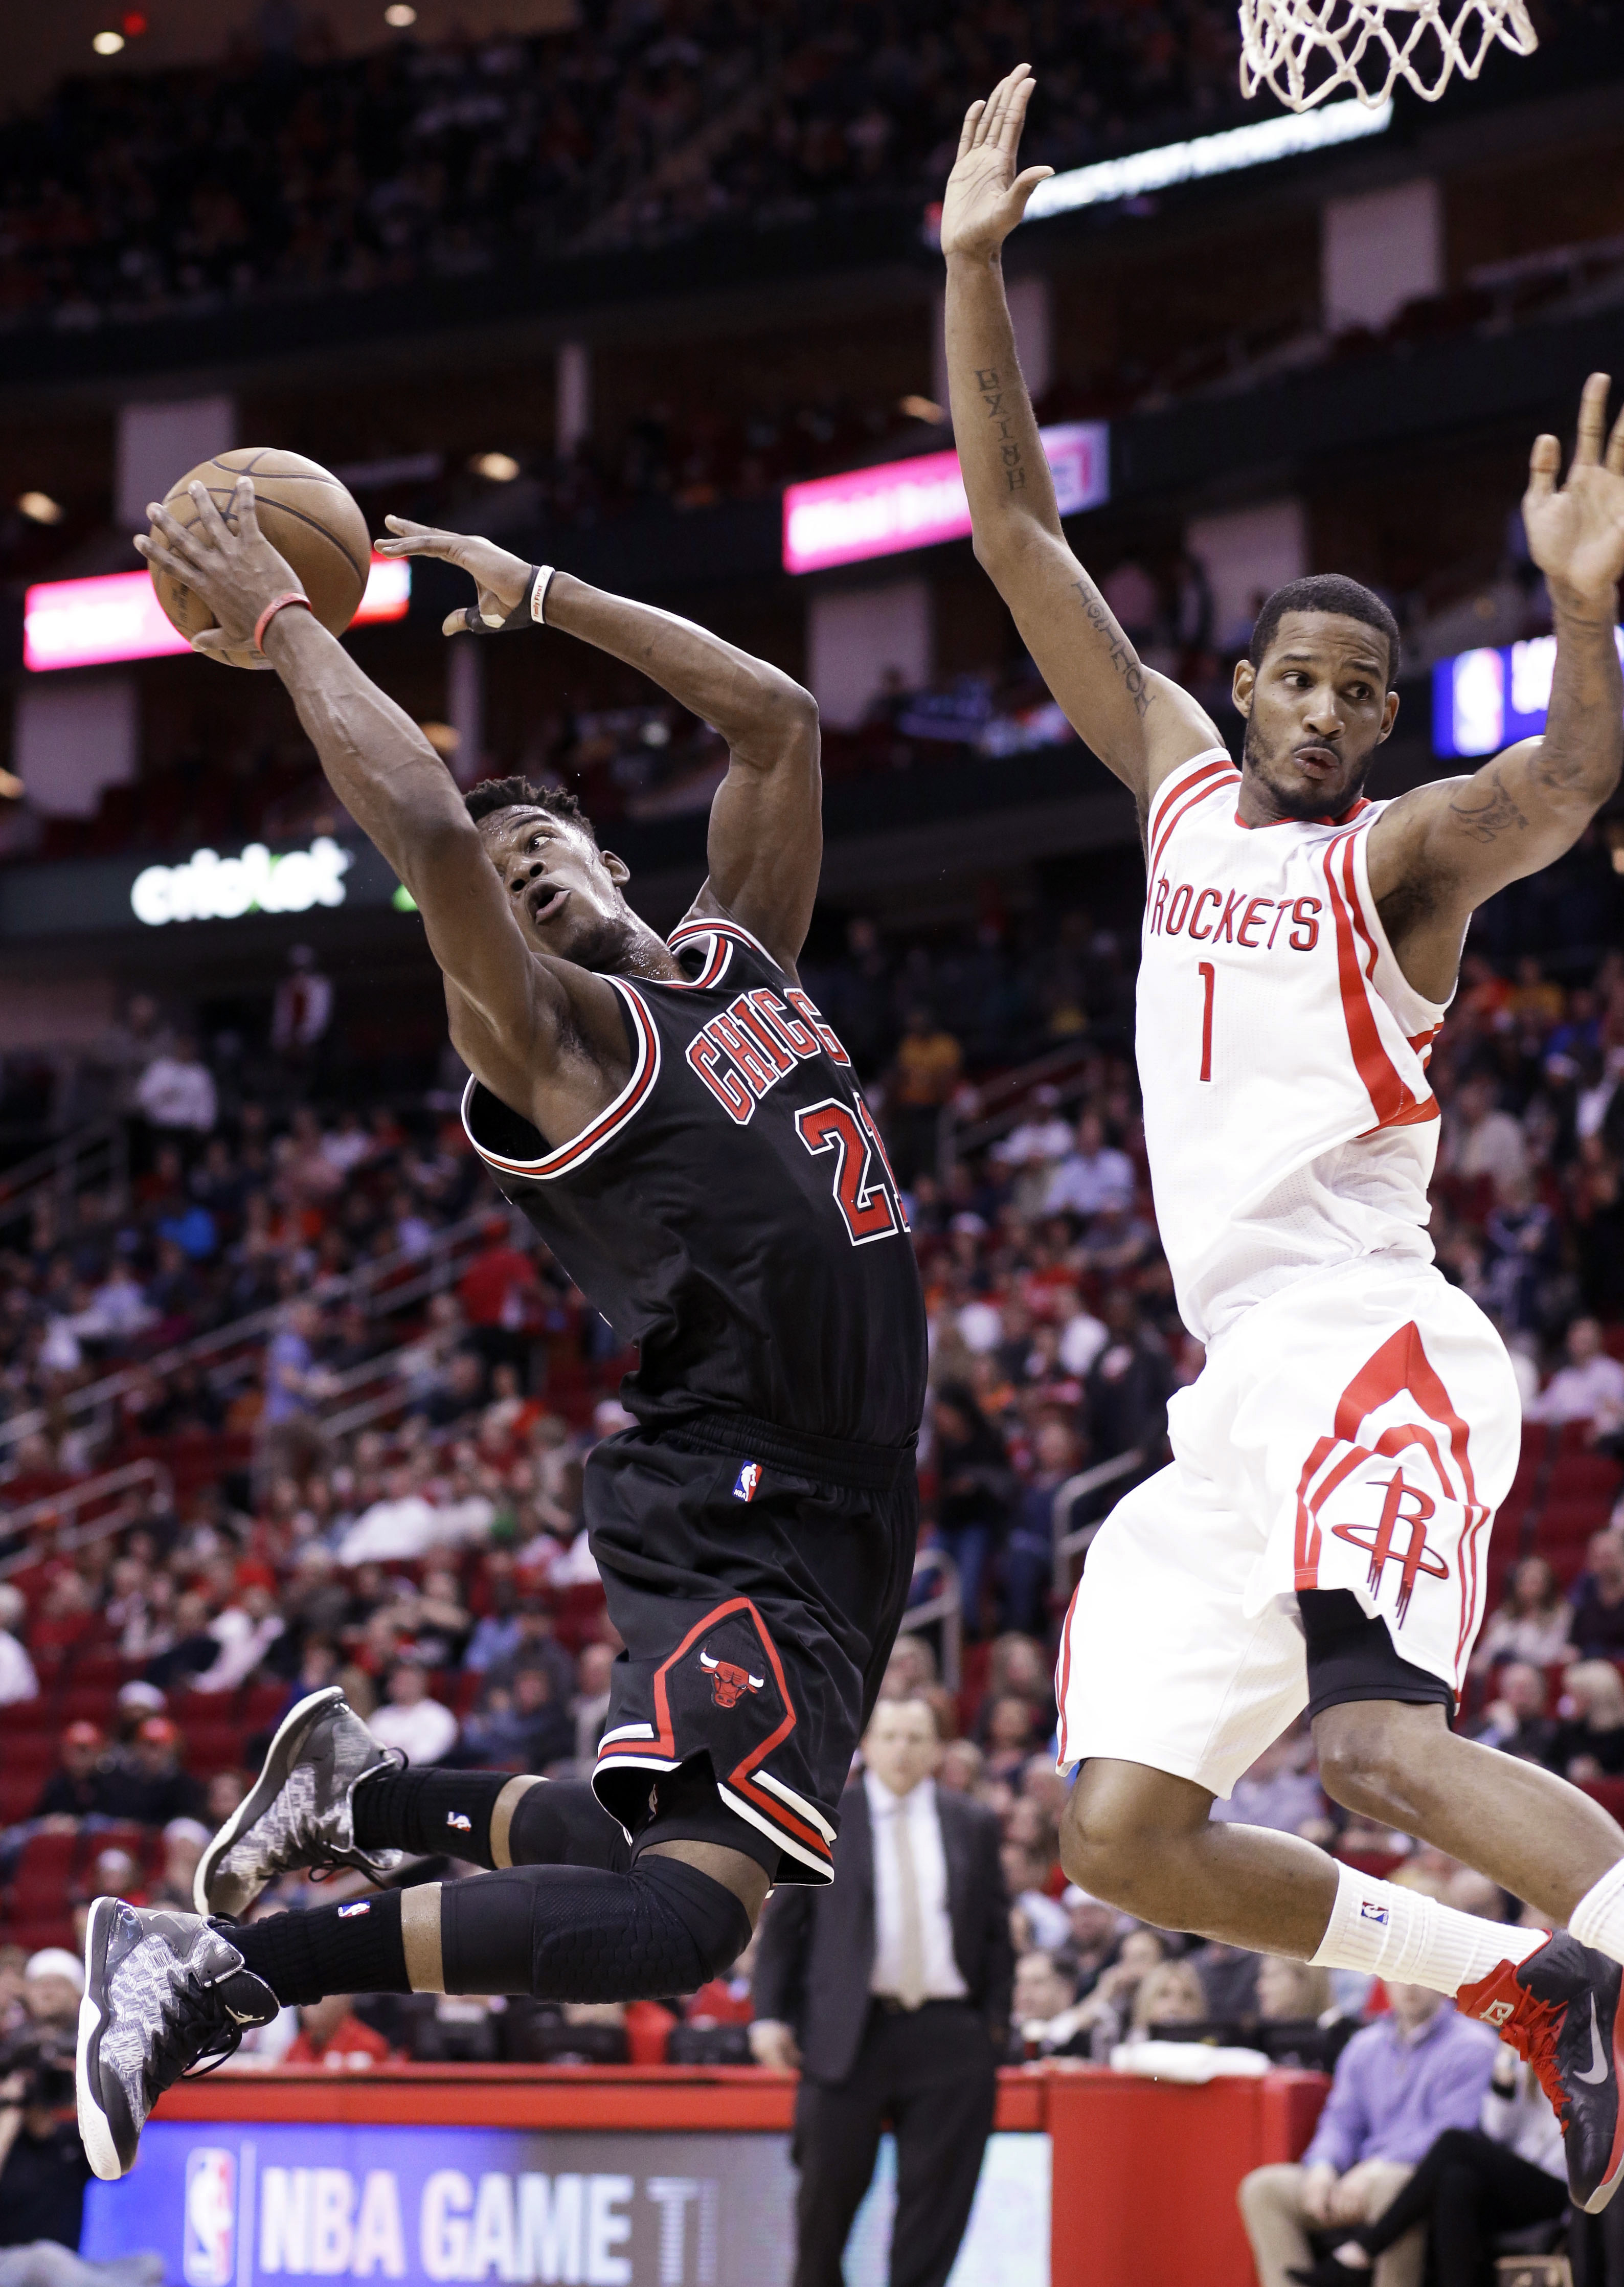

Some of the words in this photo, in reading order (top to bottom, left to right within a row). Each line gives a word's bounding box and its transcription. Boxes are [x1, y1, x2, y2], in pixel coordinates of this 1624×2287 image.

[1151, 869, 1322, 951] ROCKETS
[1198, 961, 1215, 1082] 1
[733, 1489, 746, 1499] NBA
[260, 2166, 406, 2278] NBA
[419, 2168, 634, 2284] GAME
